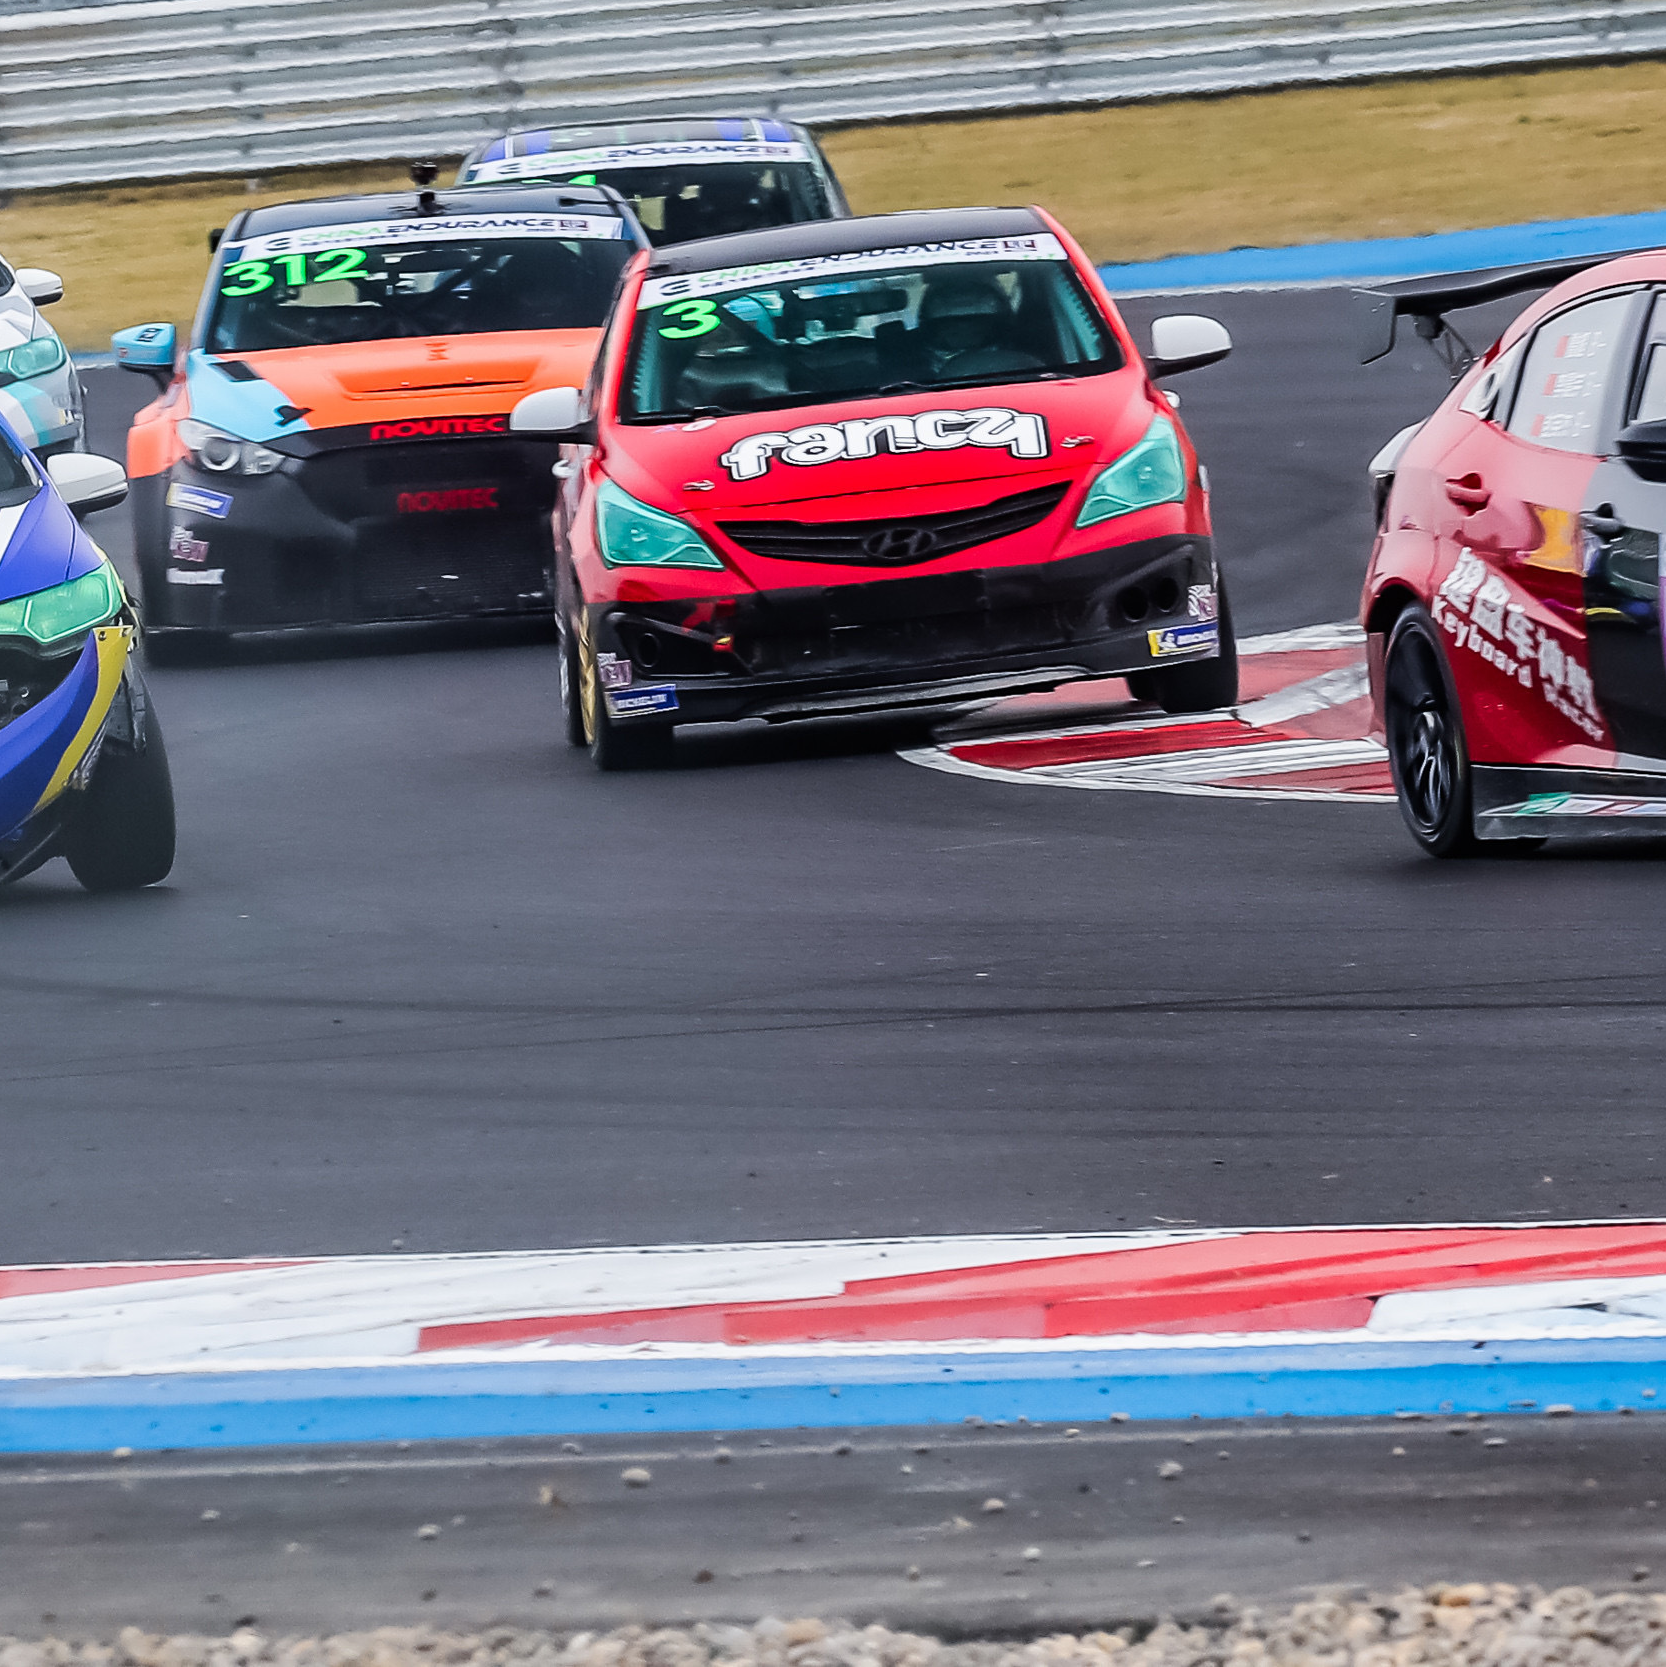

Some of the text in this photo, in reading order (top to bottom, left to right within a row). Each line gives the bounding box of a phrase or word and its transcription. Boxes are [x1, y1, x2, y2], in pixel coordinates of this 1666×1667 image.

[386, 218, 556, 234] ENDURANCE
[220, 248, 369, 297] 312
[657, 299, 722, 341] 3
[369, 417, 506, 441] NOVITEC
